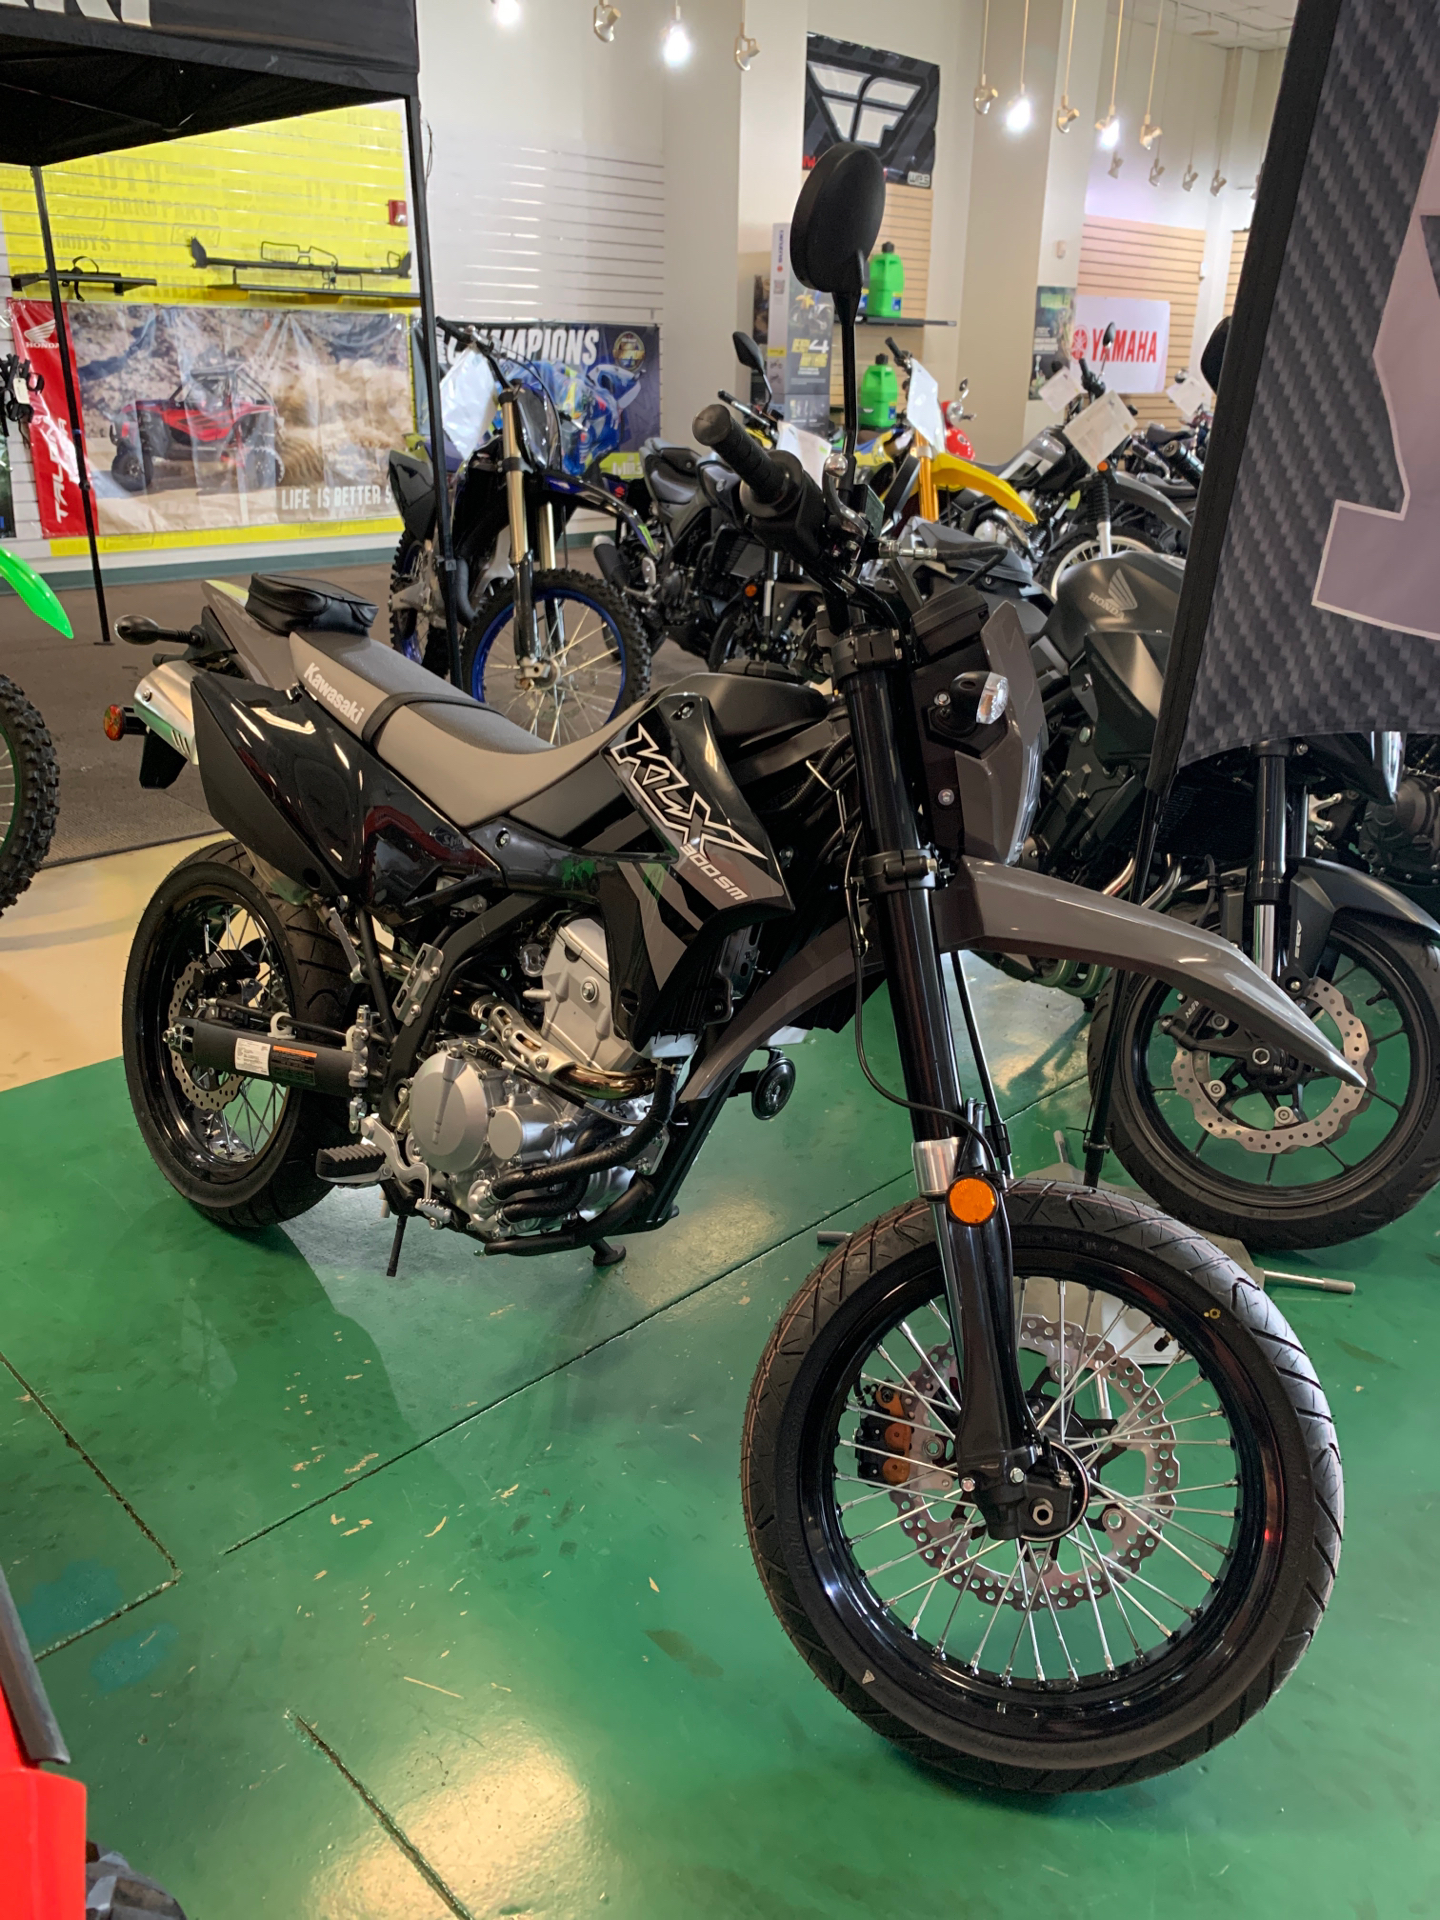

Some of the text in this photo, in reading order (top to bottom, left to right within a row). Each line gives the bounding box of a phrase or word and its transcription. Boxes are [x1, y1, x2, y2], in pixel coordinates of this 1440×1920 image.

[447, 328, 600, 366] CAMPIONS
[282, 488, 310, 510] LIFE
[317, 487, 330, 508] IS
[333, 485, 381, 507] BETTER
[1088, 592, 1125, 621] HONDA
[303, 662, 366, 725] Kawasaki
[610, 722, 769, 862] KLX
